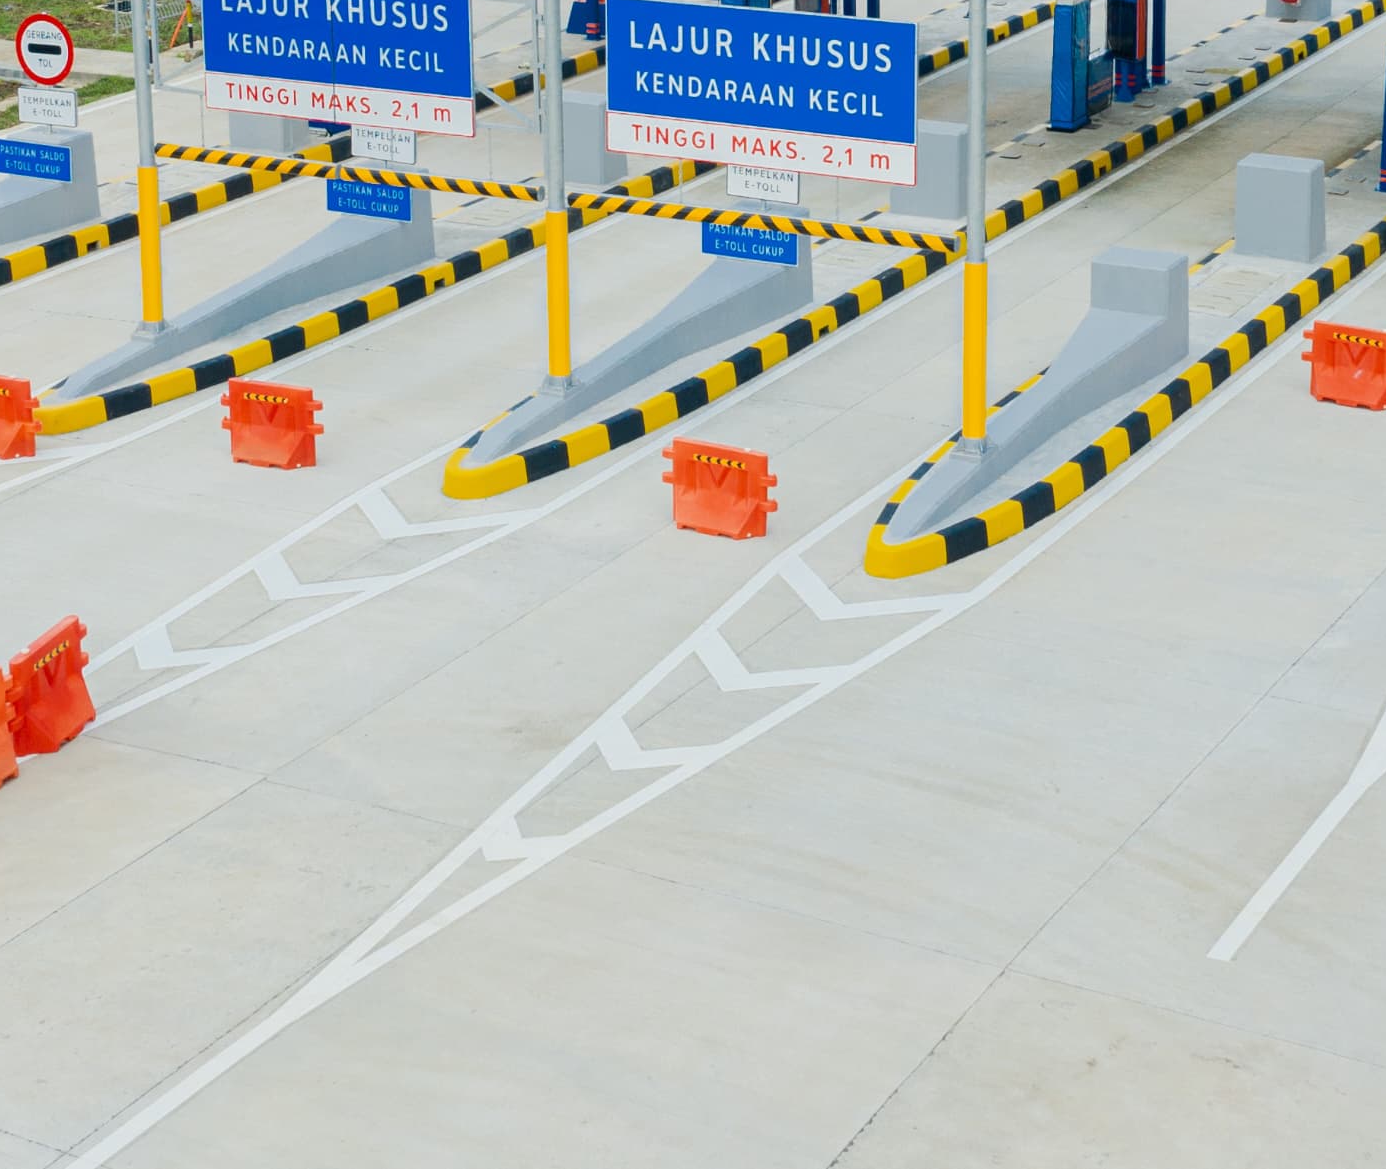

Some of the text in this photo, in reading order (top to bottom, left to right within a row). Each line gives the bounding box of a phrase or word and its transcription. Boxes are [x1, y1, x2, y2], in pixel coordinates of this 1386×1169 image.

[26, 29, 63, 41] GERBANG
[228, 32, 444, 73] KENDARAAN KECIL
[629, 20, 892, 73] LAJUR KHUSUS
[38, 58, 53, 68] TOL
[22, 95, 72, 107] TEMPELKAN
[636, 70, 883, 117] KENDARAAN KECIL
[226, 82, 451, 123] TINGGI MAKS. 2,1 m
[33, 109, 62, 118] E-TOLL
[356, 128, 411, 144] TEMPELKAN
[0, 144, 65, 162] PASTIKAN SALDO
[367, 142, 399, 153] E-TOLL
[632, 124, 890, 170] TINGGI MAKS. 2,1 m
[5, 159, 61, 175] E-TOLL CUKUP
[733, 166, 794, 182] TEMPELKAN
[333, 182, 404, 200] PASTIKAN SALDO
[744, 180, 781, 193] E-TOLL
[338, 197, 399, 214] E-TOLL CUKUP
[709, 223, 790, 242] PASTIKAN SALDO
[715, 239, 784, 257] E-TOLL CUKUP
